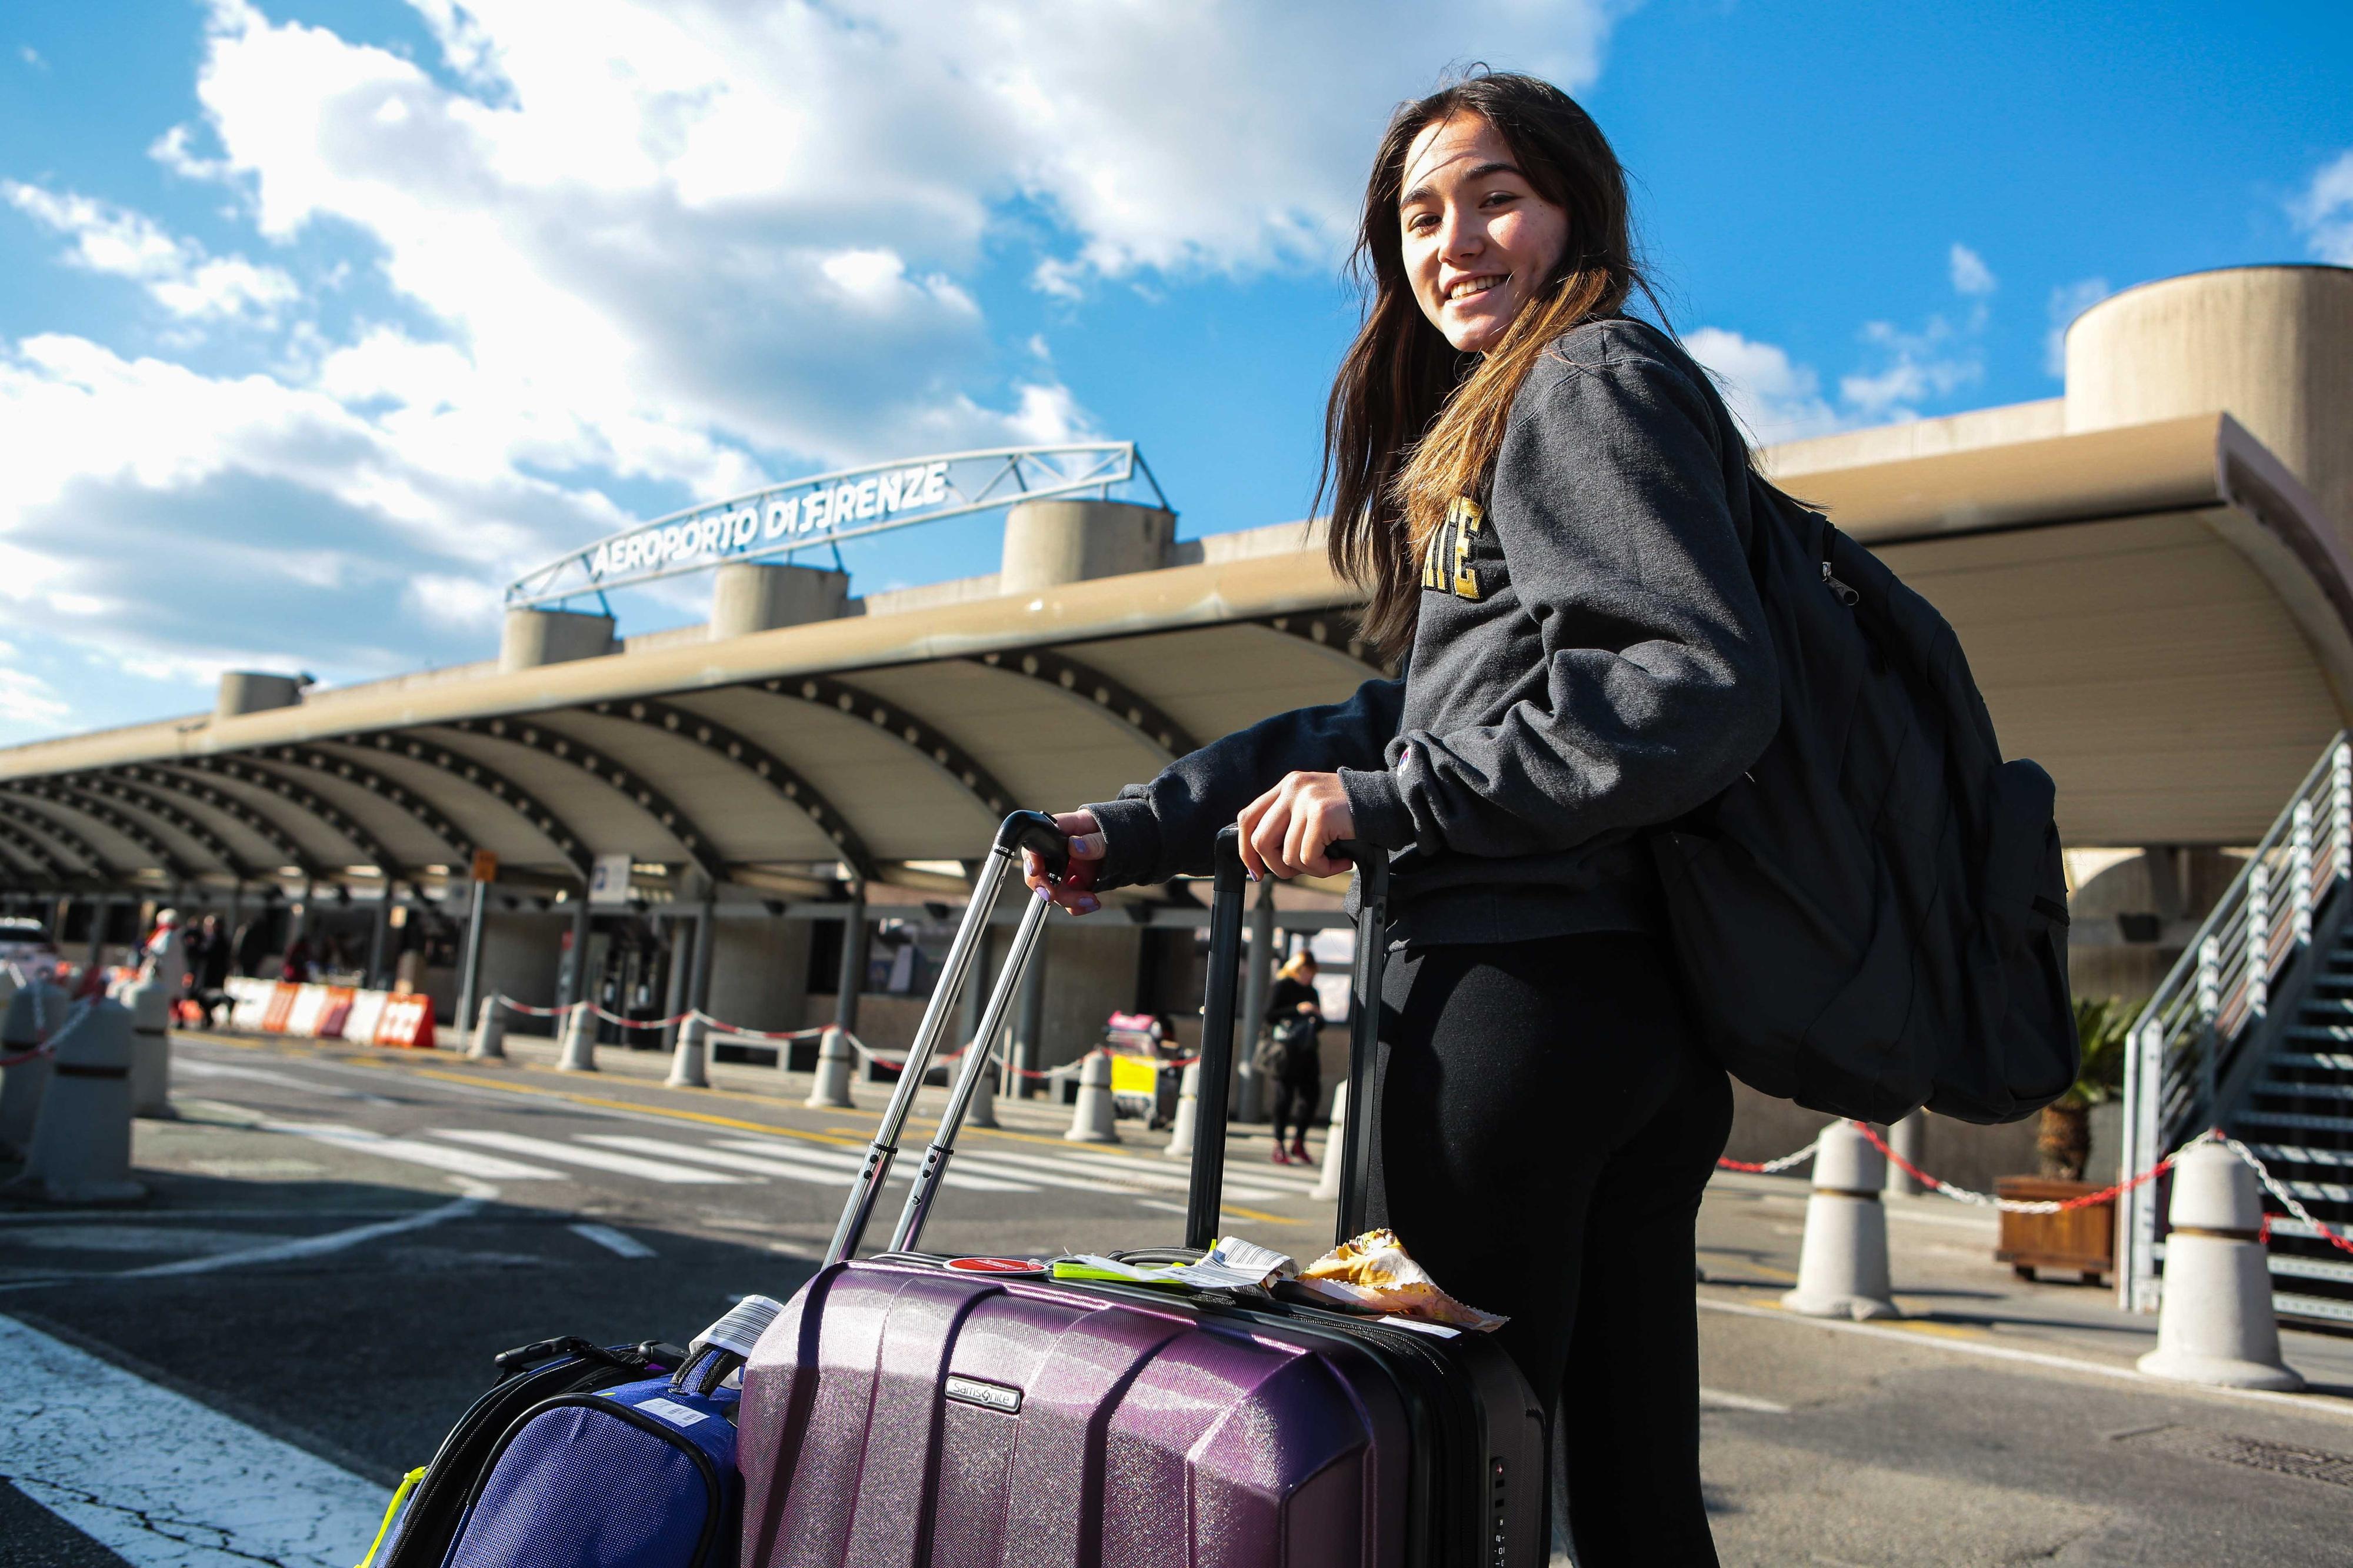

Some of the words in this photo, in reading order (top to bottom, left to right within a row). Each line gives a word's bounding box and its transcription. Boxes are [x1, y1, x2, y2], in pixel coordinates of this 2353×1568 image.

[591, 507, 759, 576] AEROPORTO
[765, 496, 799, 538] DI
[798, 462, 948, 532] FIRENZE
[953, 1382, 1009, 1404] Samsonite
